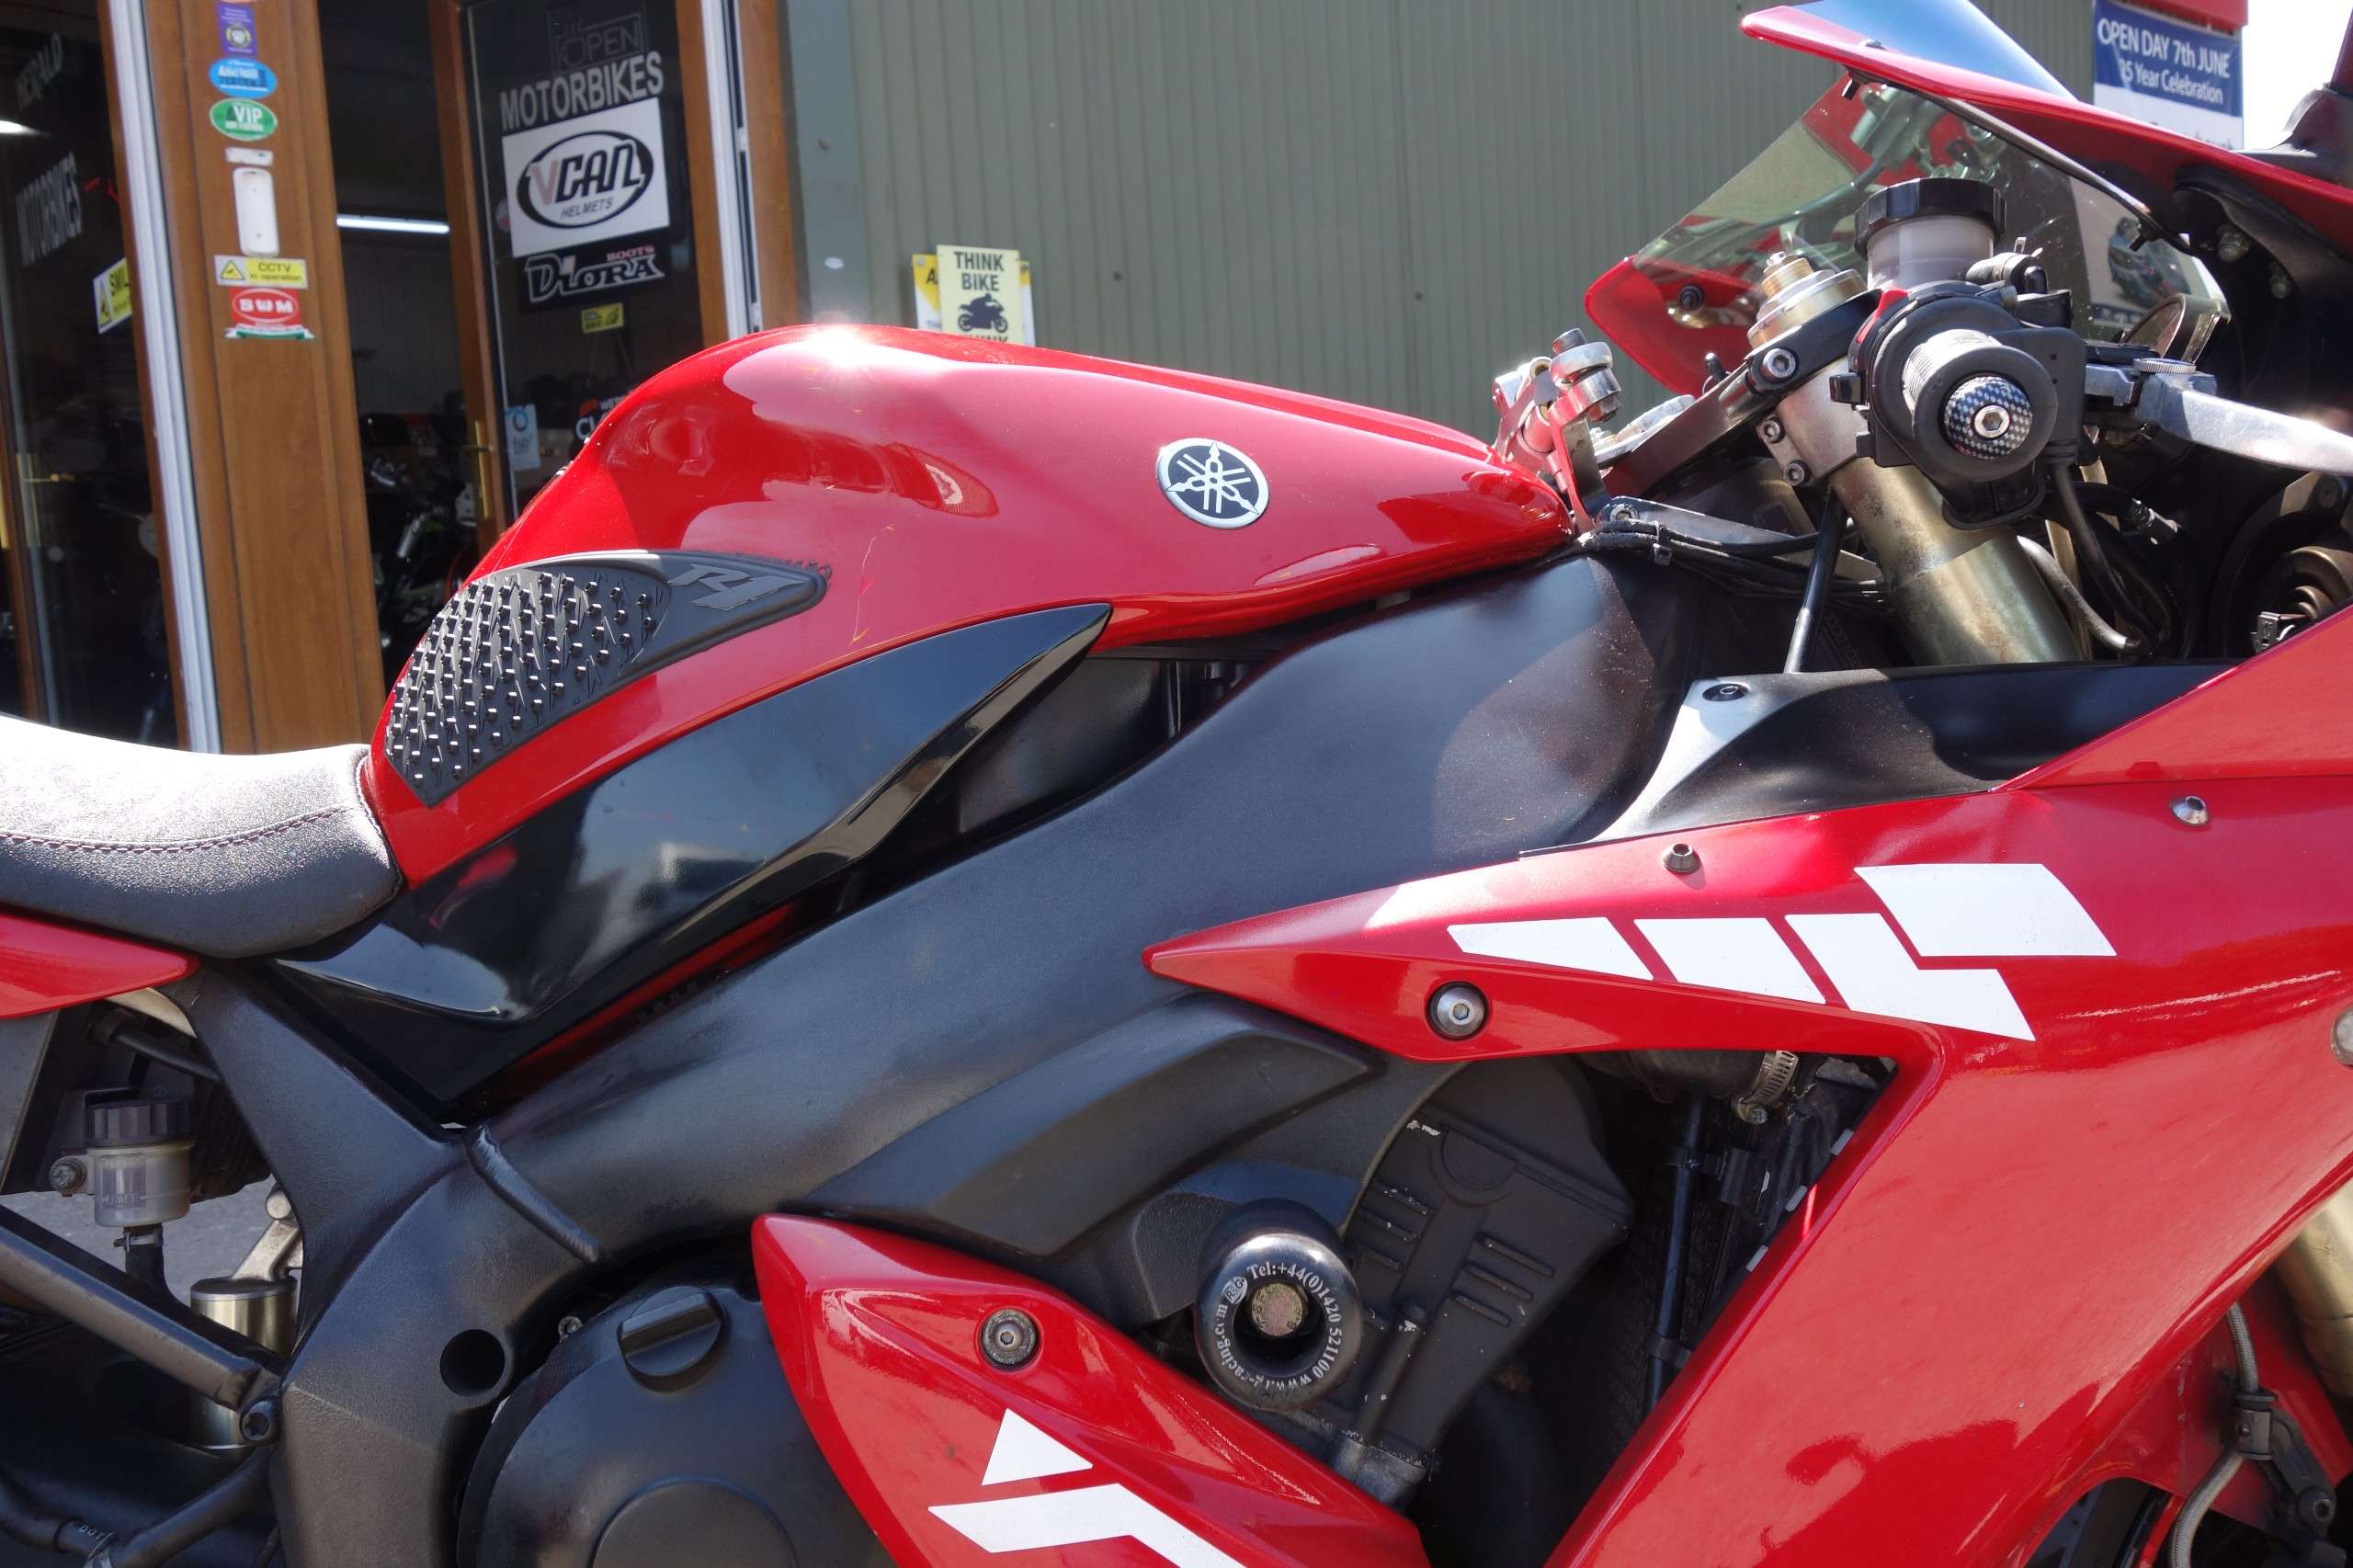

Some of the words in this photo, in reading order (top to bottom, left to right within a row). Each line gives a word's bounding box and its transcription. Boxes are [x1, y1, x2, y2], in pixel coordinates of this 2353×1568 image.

[2097, 17, 2140, 53] OPEN
[2142, 29, 2170, 61] DAY
[2173, 40, 2196, 69] 7th
[2198, 47, 2231, 78] JUNE
[501, 51, 665, 131] MOTORBIKES
[2134, 62, 2161, 89] Year
[2161, 69, 2223, 105] Celebration
[233, 105, 262, 123] VIP
[561, 197, 614, 219] HELMETS
[606, 244, 655, 262] BOOTS
[954, 251, 1004, 271] THINK
[258, 262, 291, 272] CCTV
[961, 273, 1000, 291] BIKE
[1312, 1326, 1342, 1378] 521100
